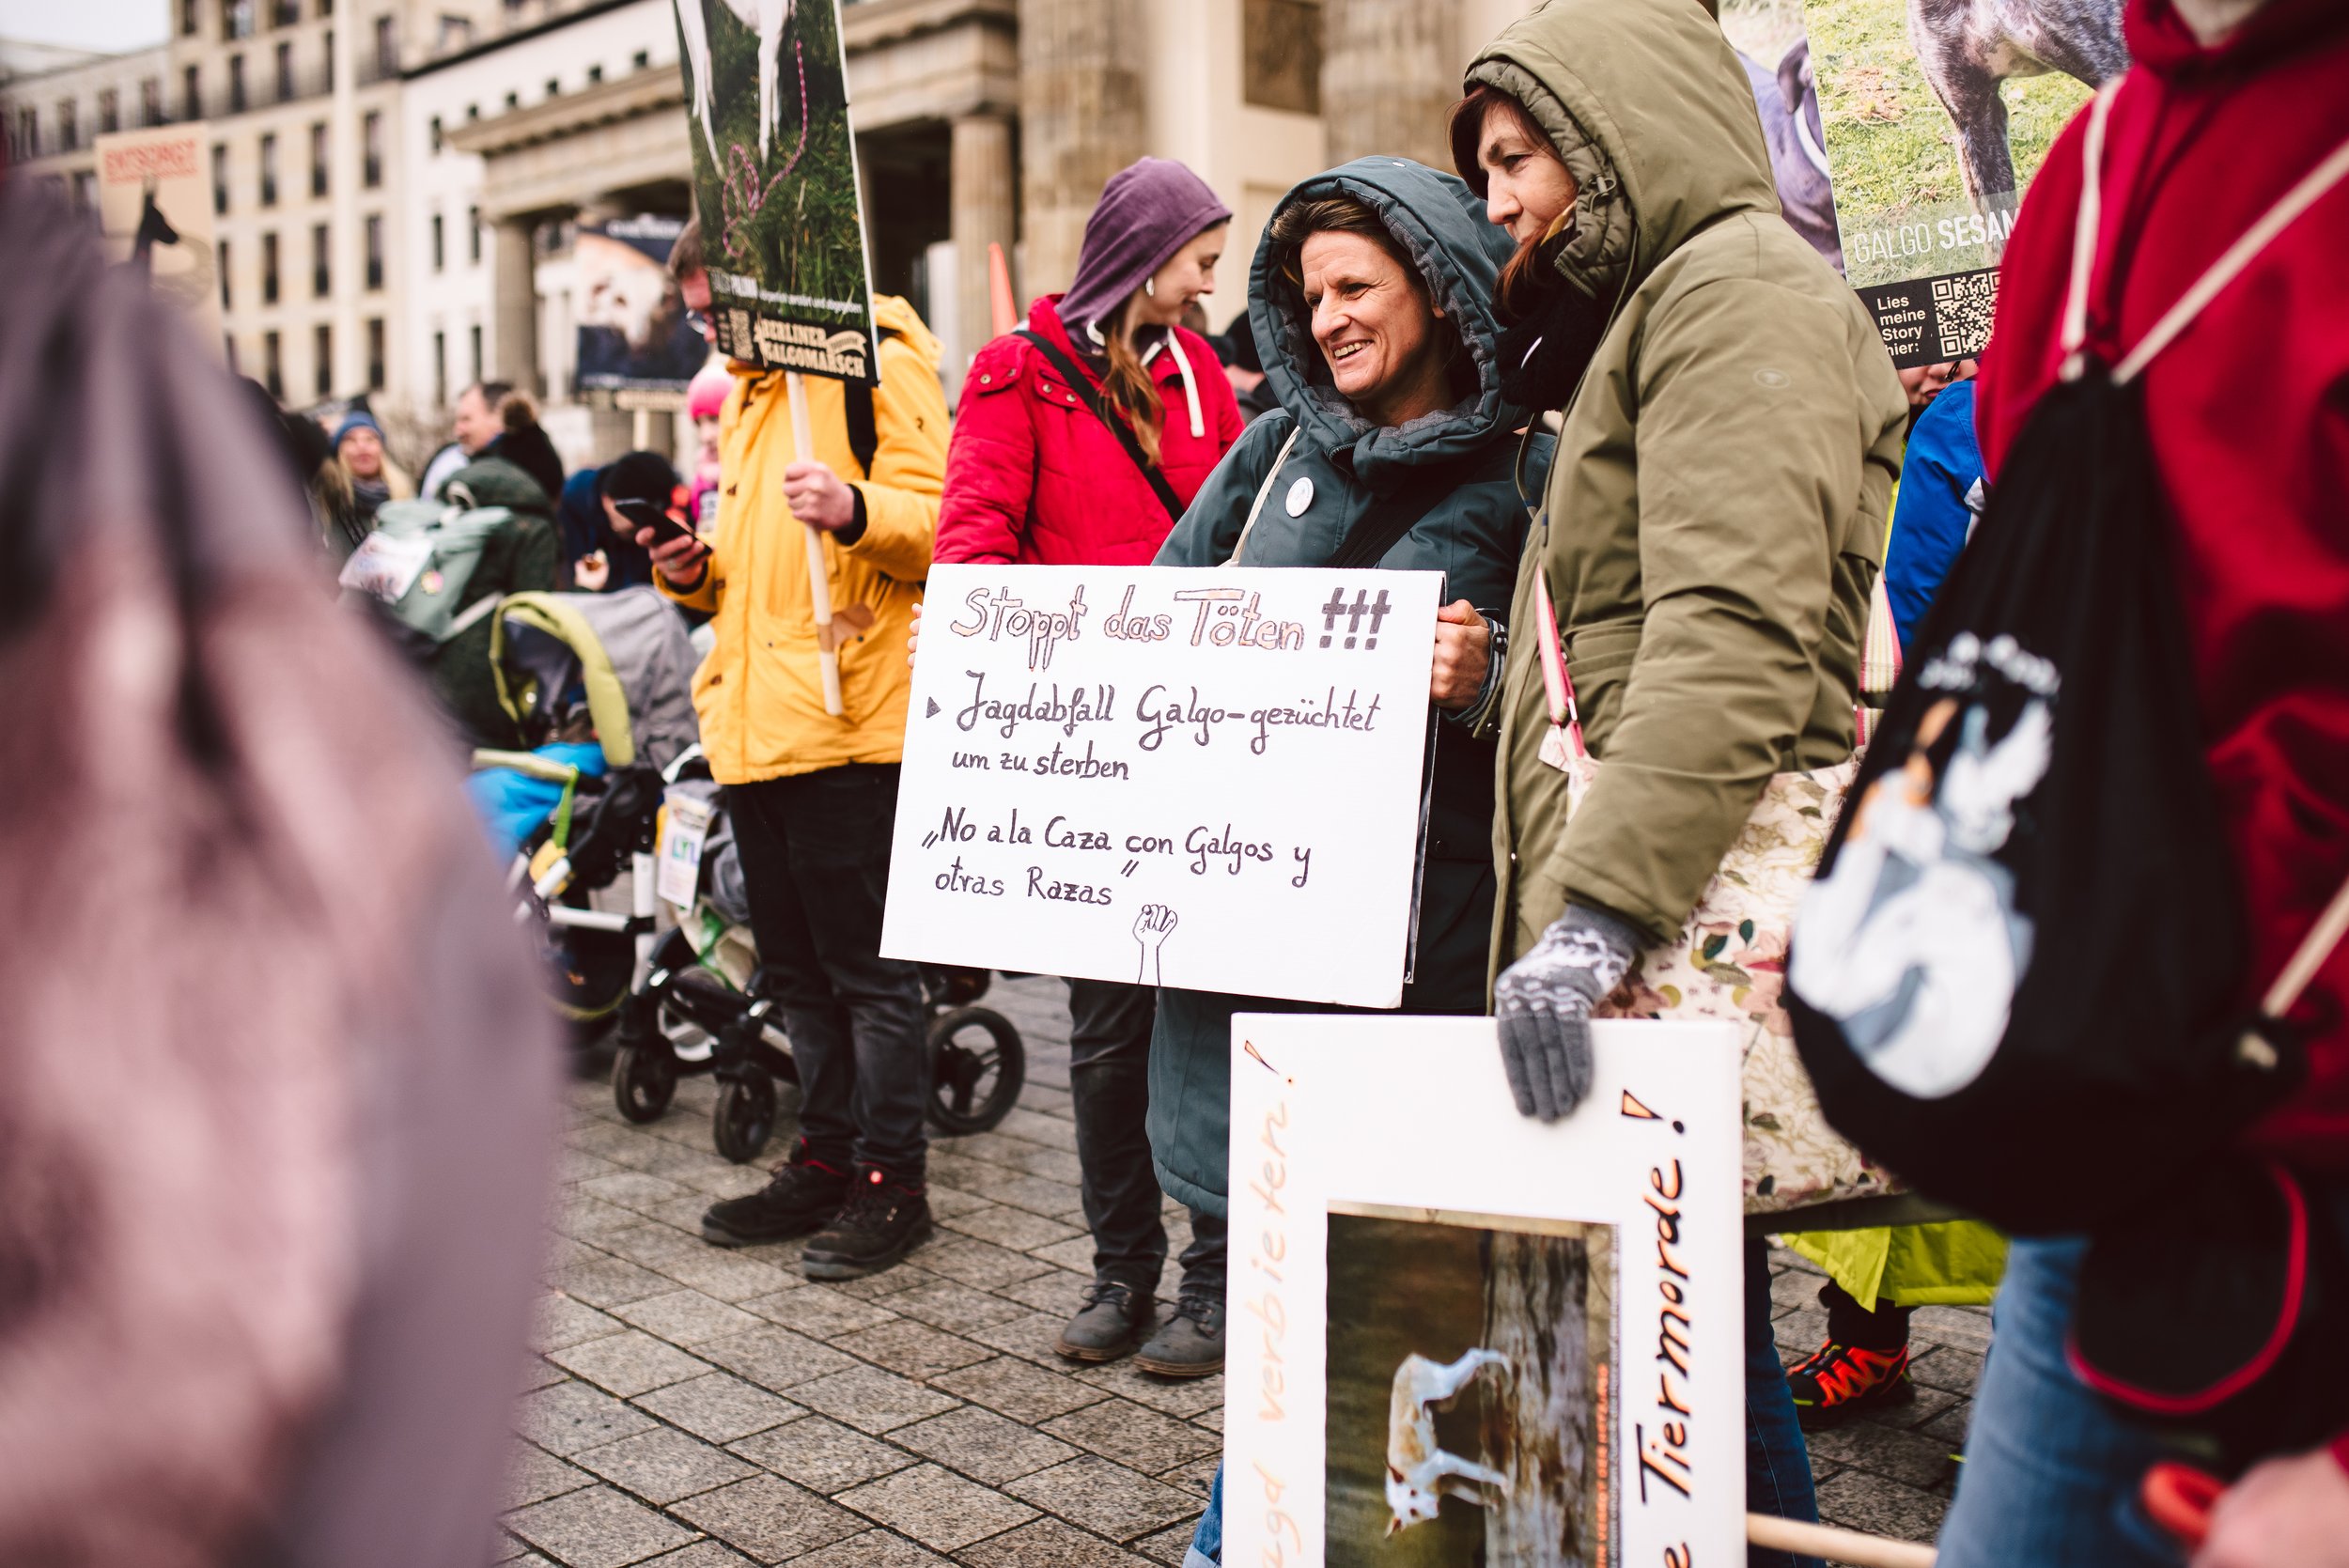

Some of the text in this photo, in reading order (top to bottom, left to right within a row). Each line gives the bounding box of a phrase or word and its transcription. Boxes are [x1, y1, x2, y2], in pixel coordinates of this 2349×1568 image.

[1853, 224, 1932, 263] GALGO
[1876, 296, 1910, 311] Lies
[1879, 309, 1926, 326] meine
[1882, 326, 1922, 347] Story
[950, 583, 1088, 673] Stoppt
[1103, 584, 1171, 643] das
[1174, 588, 1305, 652] Töten
[956, 669, 1115, 738] Jagdabfall
[951, 739, 1129, 782] um zu sterben
[987, 823, 1005, 846] a
[1007, 807, 1033, 846] la
[1044, 815, 1112, 852] Caza
[1125, 834, 1175, 856] con
[1184, 823, 1274, 877] Galgos
[1292, 844, 1313, 890] y
[934, 855, 1005, 898] otras
